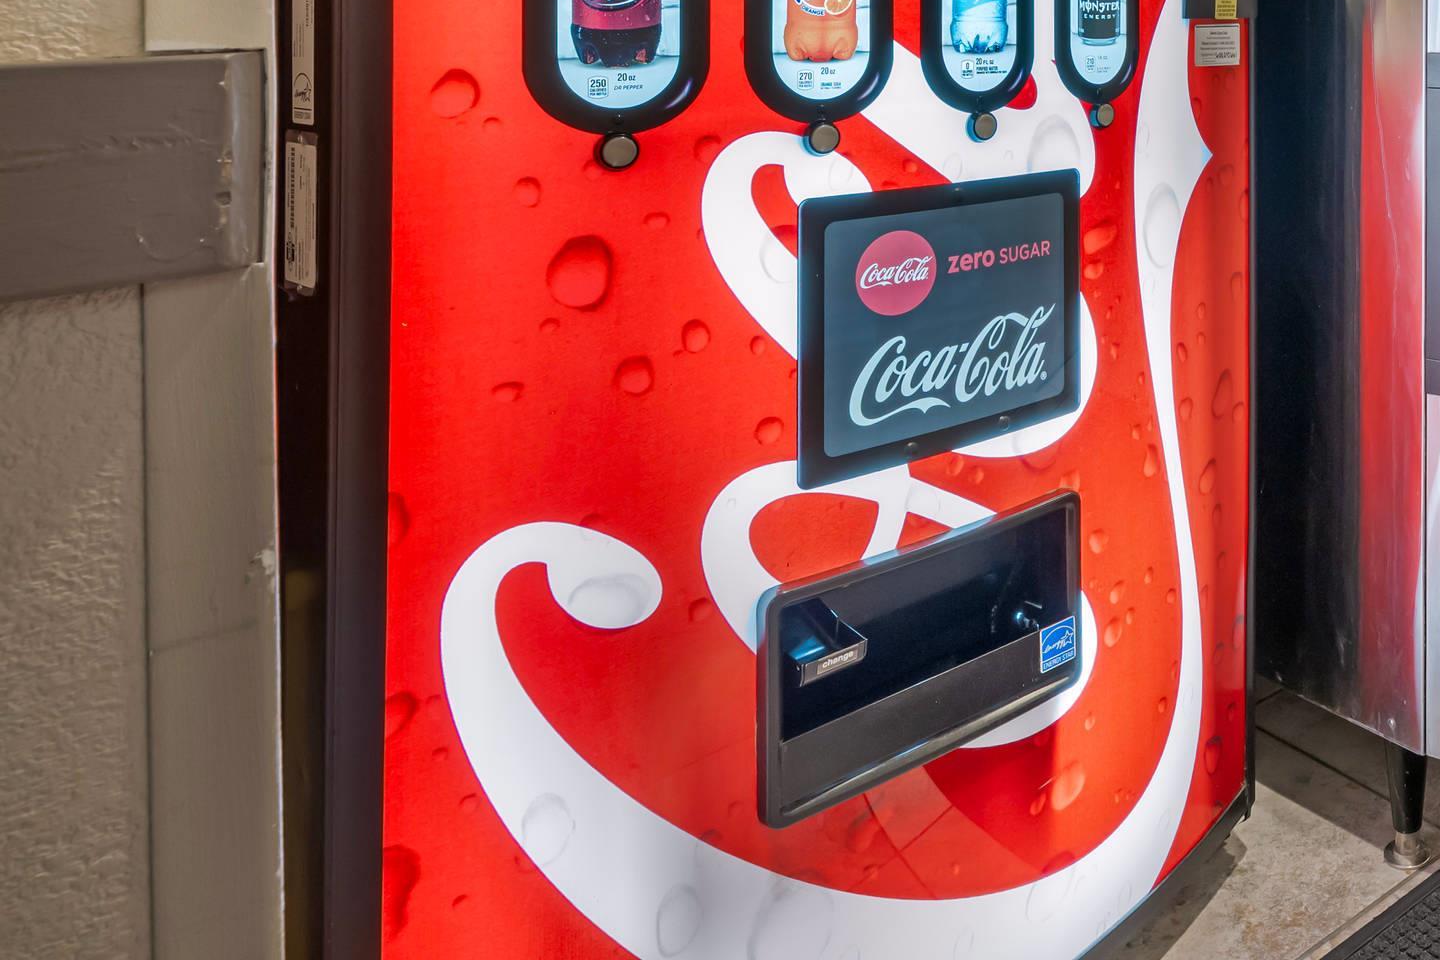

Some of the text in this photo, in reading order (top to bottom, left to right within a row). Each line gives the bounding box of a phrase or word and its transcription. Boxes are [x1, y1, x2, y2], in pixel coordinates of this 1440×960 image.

[801, 5, 824, 15] ORANGE
[1080, 0, 1120, 13] MONSTER
[820, 66, 829, 75] 20
[617, 72, 628, 82] 20
[799, 72, 813, 81] 270
[590, 79, 607, 88] 250
[947, 240, 1051, 274] zero SUGAR
[859, 256, 933, 289] Coca-Cola
[849, 303, 1056, 427] Coca-Cola
[822, 650, 854, 669] change
